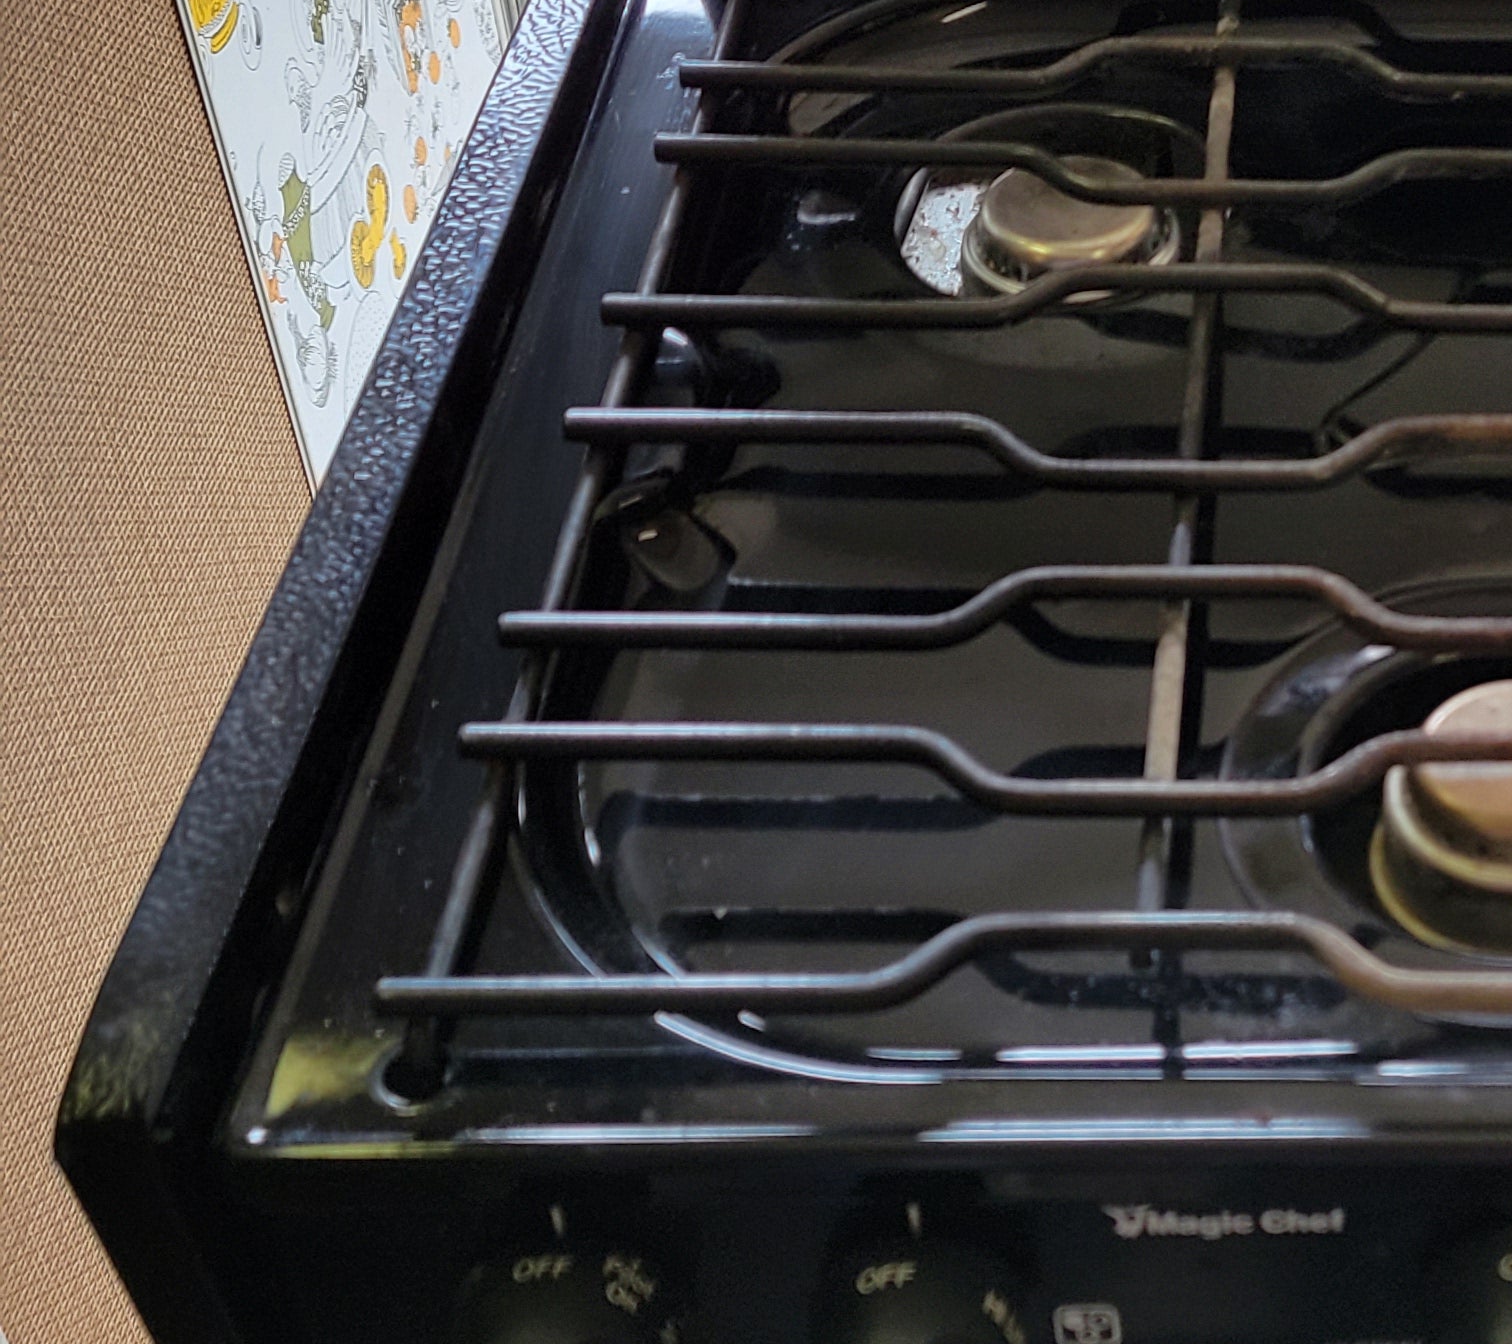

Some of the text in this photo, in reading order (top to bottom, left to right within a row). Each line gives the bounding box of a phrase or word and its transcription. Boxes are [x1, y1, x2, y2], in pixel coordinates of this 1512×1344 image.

[1145, 1207, 1345, 1240] Magic Chef
[512, 1253, 574, 1283] OFF
[855, 1259, 917, 1294] OFF
